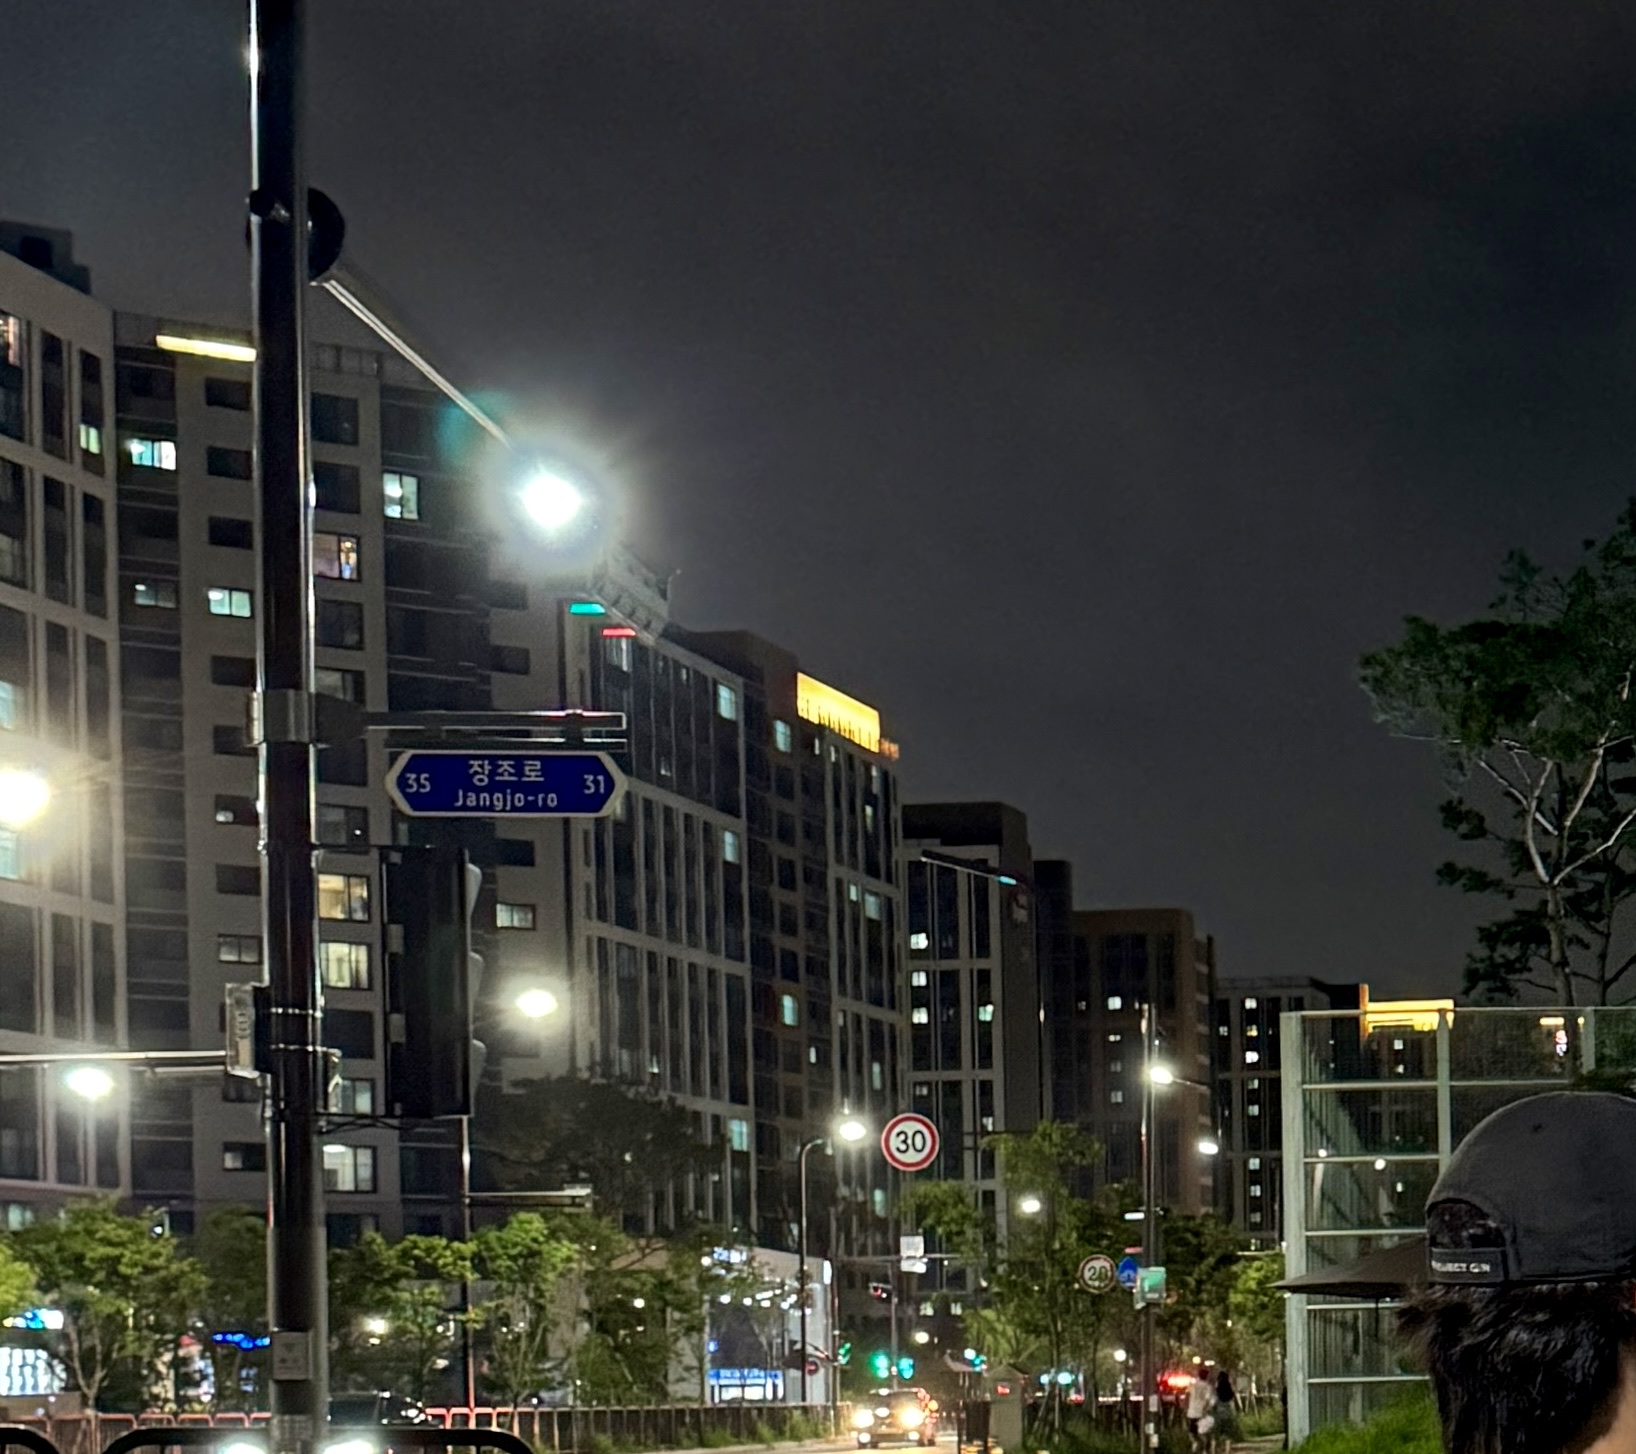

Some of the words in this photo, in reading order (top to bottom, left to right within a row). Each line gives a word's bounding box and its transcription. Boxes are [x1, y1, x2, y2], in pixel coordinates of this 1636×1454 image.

[405, 773, 431, 793] 35
[468, 759, 545, 786] 장조로
[583, 774, 605, 794] 31
[454, 789, 558, 811] Jangjo-ro
[896, 1130, 926, 1154] 30
[1087, 1266, 1108, 1281] 20
